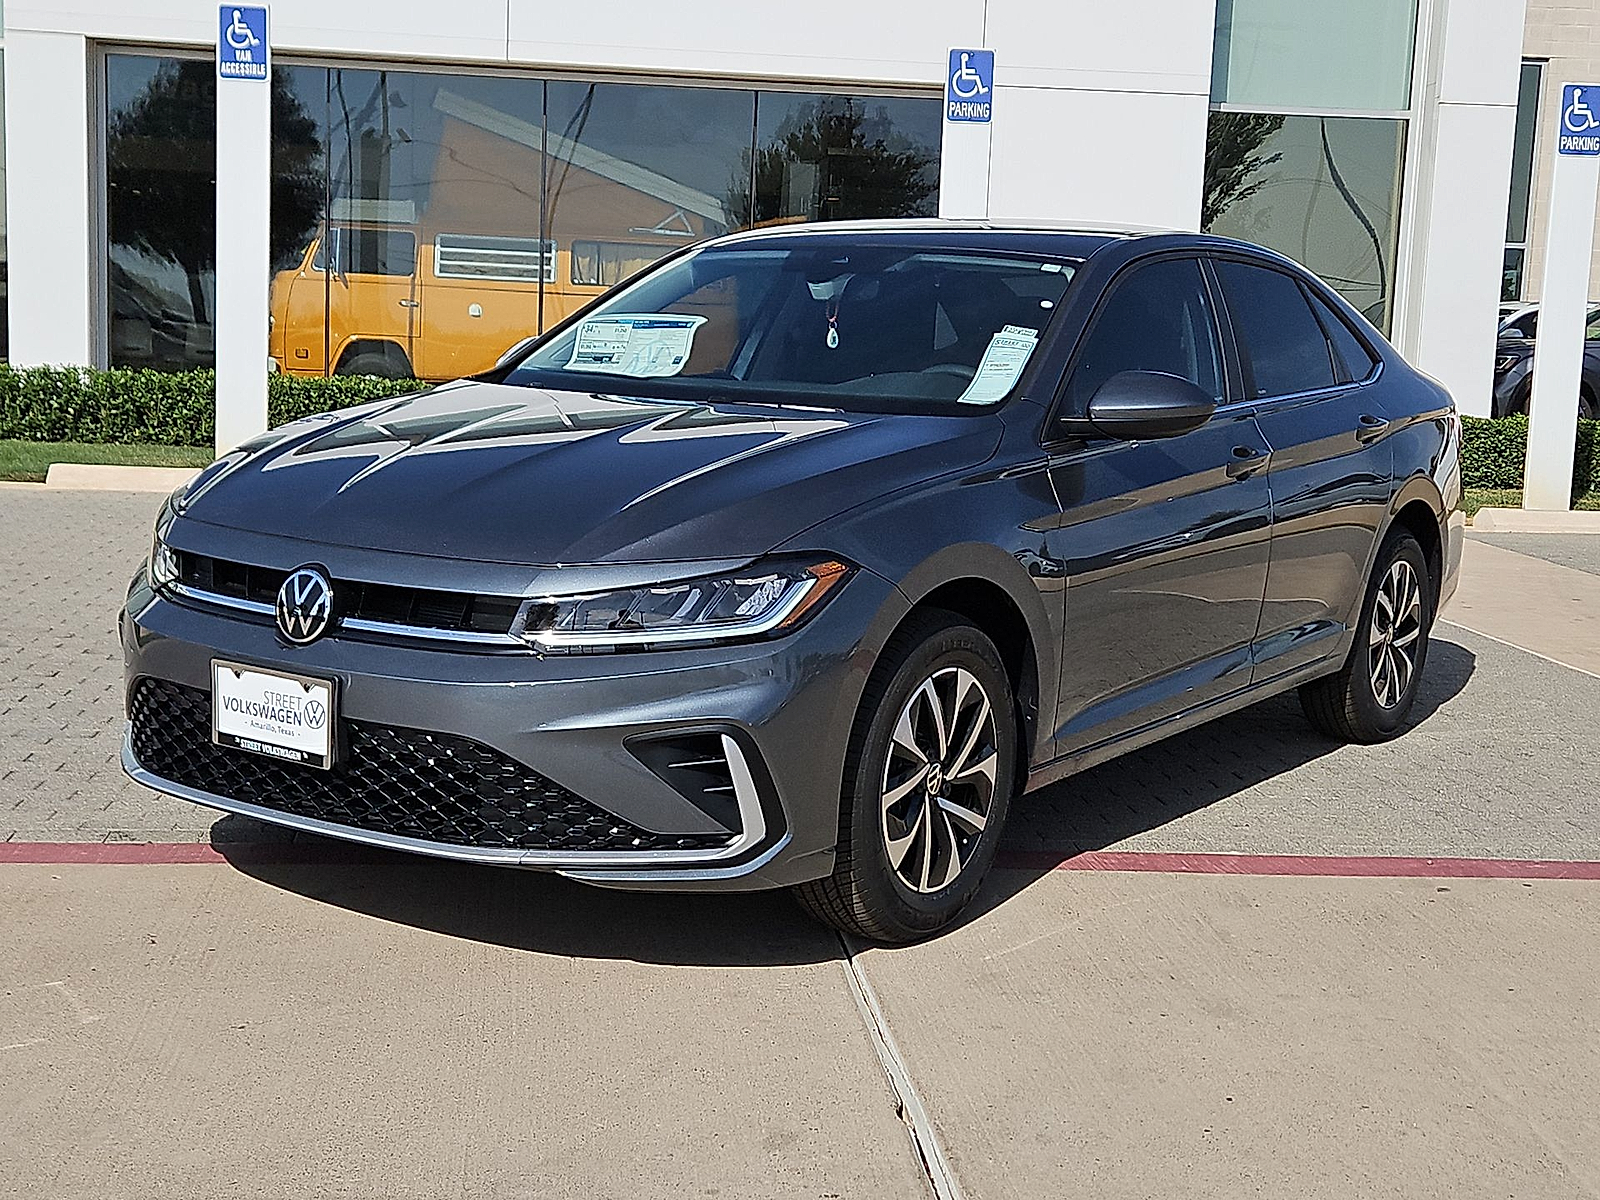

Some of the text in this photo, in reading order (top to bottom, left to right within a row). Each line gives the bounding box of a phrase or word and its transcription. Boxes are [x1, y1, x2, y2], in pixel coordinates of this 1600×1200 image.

[235, 49, 253, 62] VAN
[221, 61, 266, 75] ACCESSIBLE
[949, 101, 990, 118] PARKING
[1560, 136, 1600, 151] PARKING
[263, 691, 303, 711] STREET
[222, 695, 302, 727] VOLKSWAGEN
